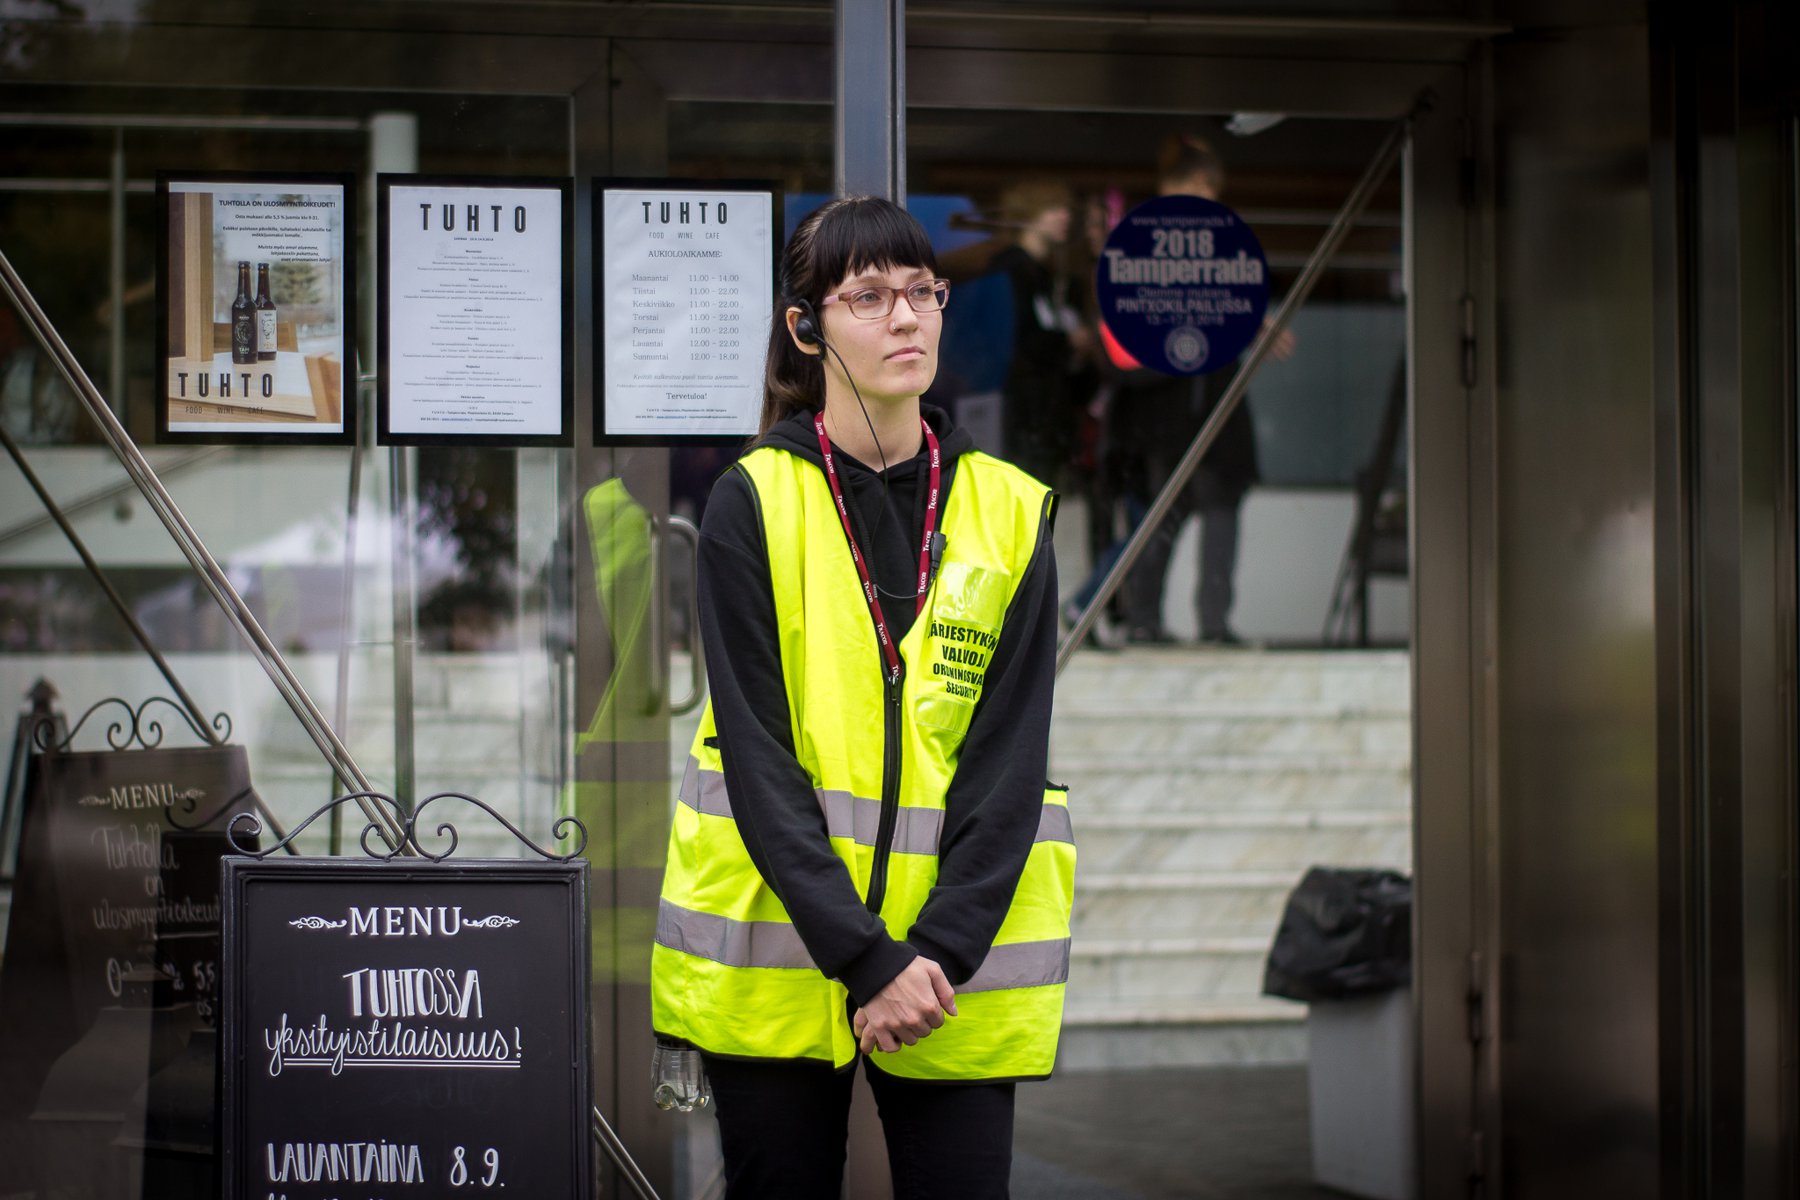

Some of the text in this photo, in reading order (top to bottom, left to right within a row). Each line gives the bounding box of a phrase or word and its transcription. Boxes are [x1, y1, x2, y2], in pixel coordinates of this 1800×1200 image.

[420, 204, 526, 233] TUHTO
[642, 202, 728, 224] TUHTO
[705, 232, 720, 240] CAFE
[1152, 228, 1214, 258] 2018
[648, 250, 723, 258] AUKIOLOAIKAMME:
[1104, 249, 1263, 287] Tamperrada
[632, 274, 669, 282] Maanantai
[689, 274, 709, 282] 11.00
[719, 274, 739, 282] 14.00
[632, 300, 675, 308] Keskiviikko
[1116, 299, 1252, 313] PINTXOKILPAILUSSA
[633, 313, 659, 321] Torstai
[633, 327, 665, 335] Perjantai
[178, 373, 273, 398] TUHTO
[666, 392, 708, 400] Tervetuloa!
[186, 406, 203, 414] FOOD
[217, 406, 234, 414] WINE
[942, 645, 986, 668] VALVOJ
[110, 784, 175, 810] MENU
[350, 906, 462, 936] MENU
[342, 967, 483, 1018] TUHTOSSA
